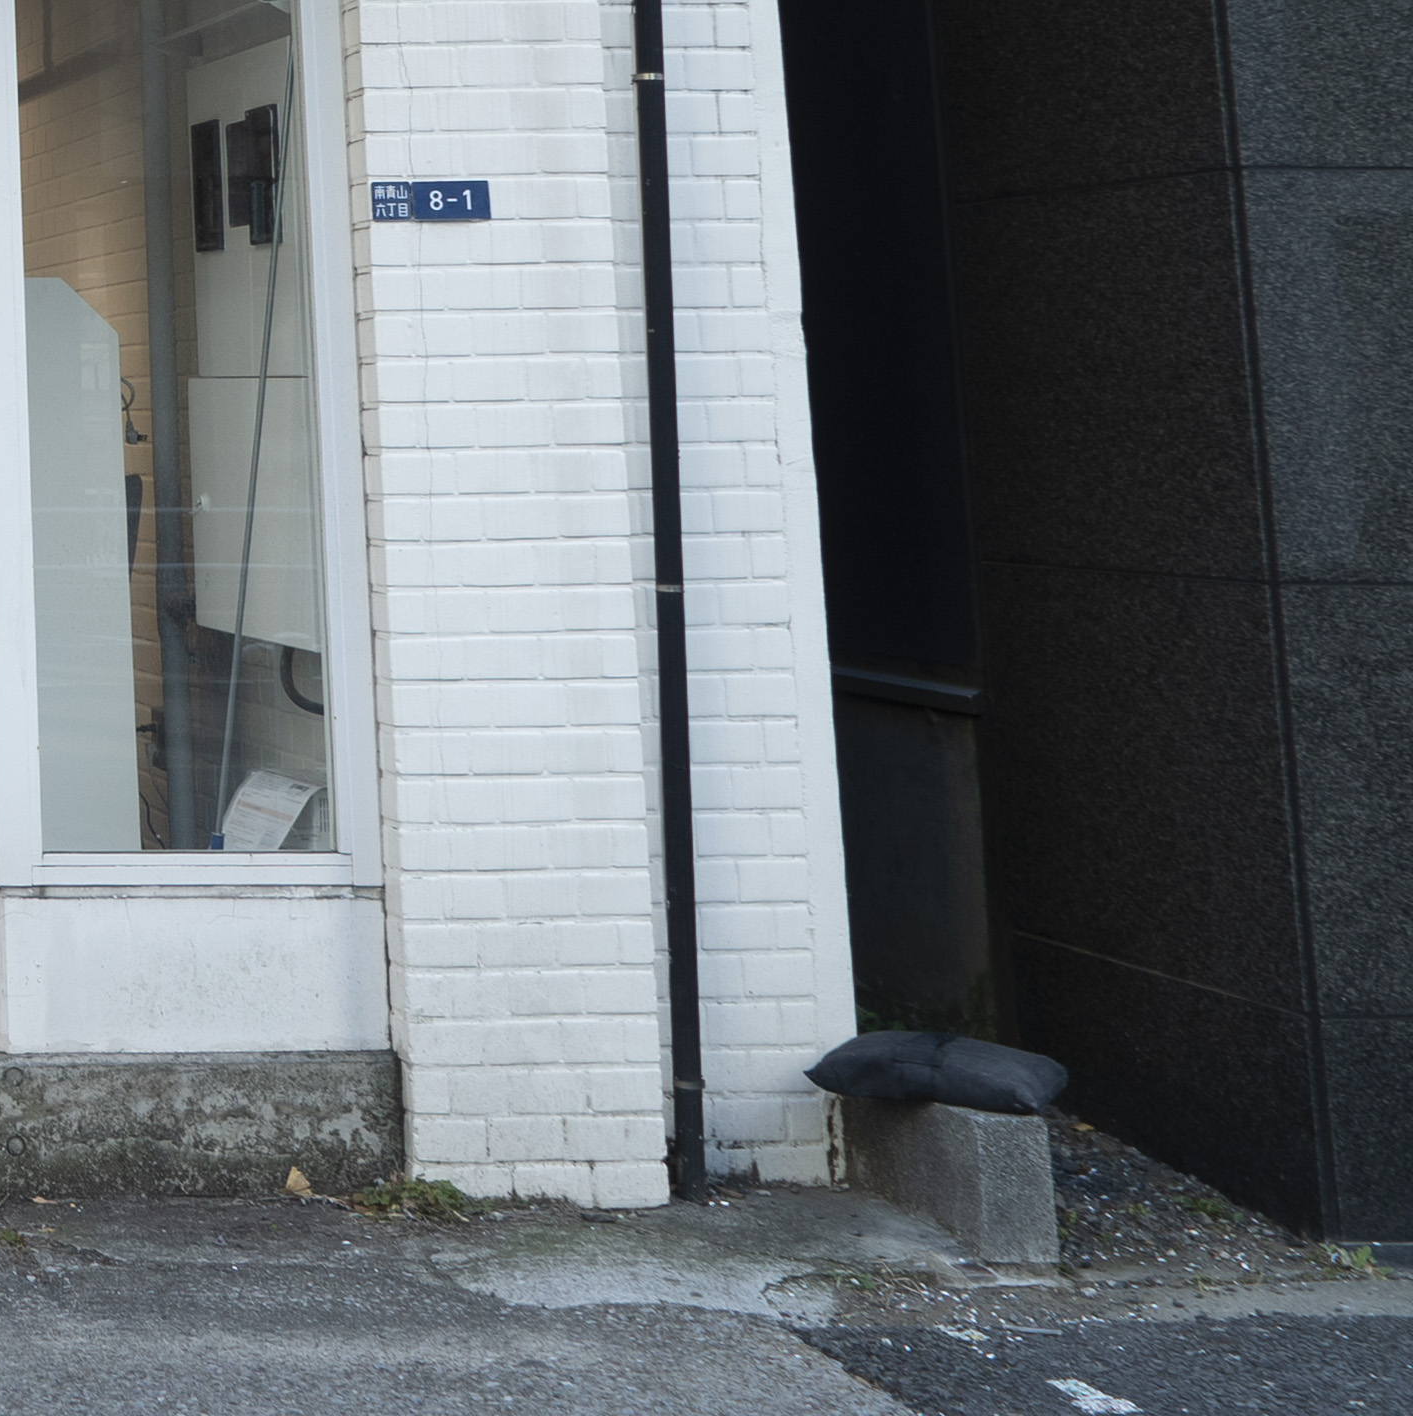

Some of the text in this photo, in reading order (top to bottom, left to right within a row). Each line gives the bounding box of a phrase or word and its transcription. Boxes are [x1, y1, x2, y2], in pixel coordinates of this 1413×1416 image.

[374, 184, 408, 200] 南青山
[429, 189, 473, 211] 8-1
[375, 203, 409, 218] 六丁目
